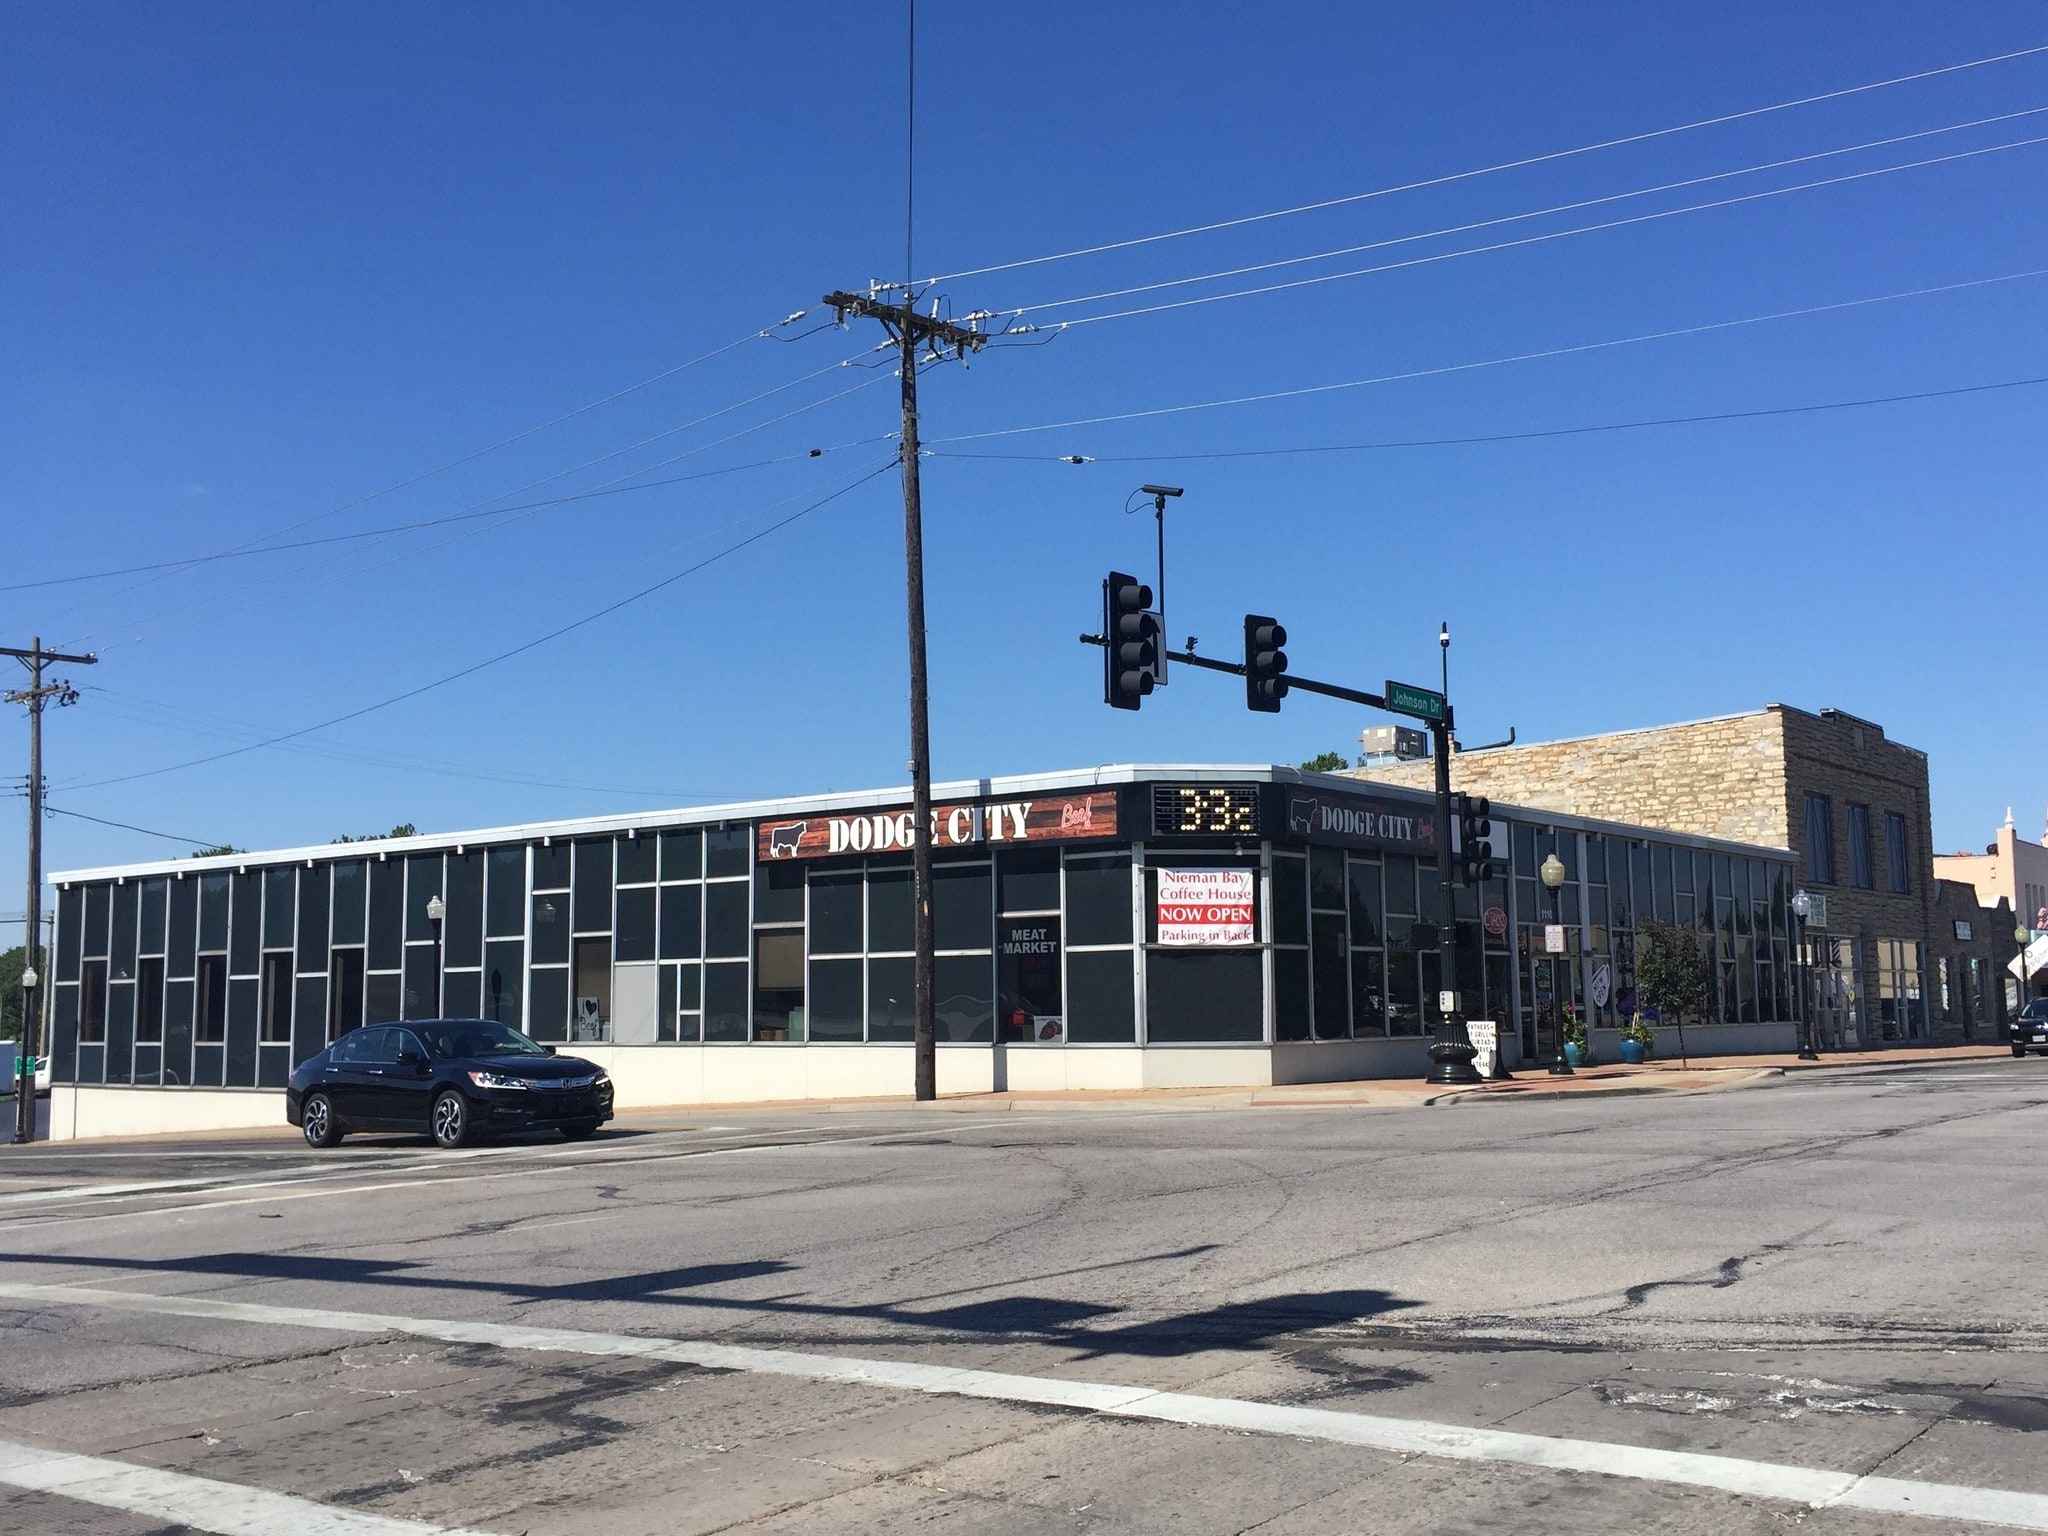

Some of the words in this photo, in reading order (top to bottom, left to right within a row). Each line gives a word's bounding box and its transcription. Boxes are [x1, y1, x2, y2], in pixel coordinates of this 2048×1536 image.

[1393, 690, 1427, 710] Johnson
[1430, 698, 1440, 713] Dr
[1060, 797, 1092, 829] Beef
[948, 802, 1032, 842] CITY
[1320, 805, 1375, 836] DODGE
[1378, 814, 1414, 841] CITY
[1164, 871, 1217, 883] Nieman
[1222, 871, 1245, 887] Bay
[1160, 887, 1204, 900] Coffee
[1208, 888, 1251, 900] House
[1160, 908, 1204, 921] NOW
[1207, 908, 1251, 921] OPEN
[1012, 929, 1047, 941] MEAT
[1162, 930, 1206, 943] Parking
[1209, 930, 1220, 940] in
[1224, 930, 1251, 940] Back
[1003, 941, 1056, 954] MARKET
